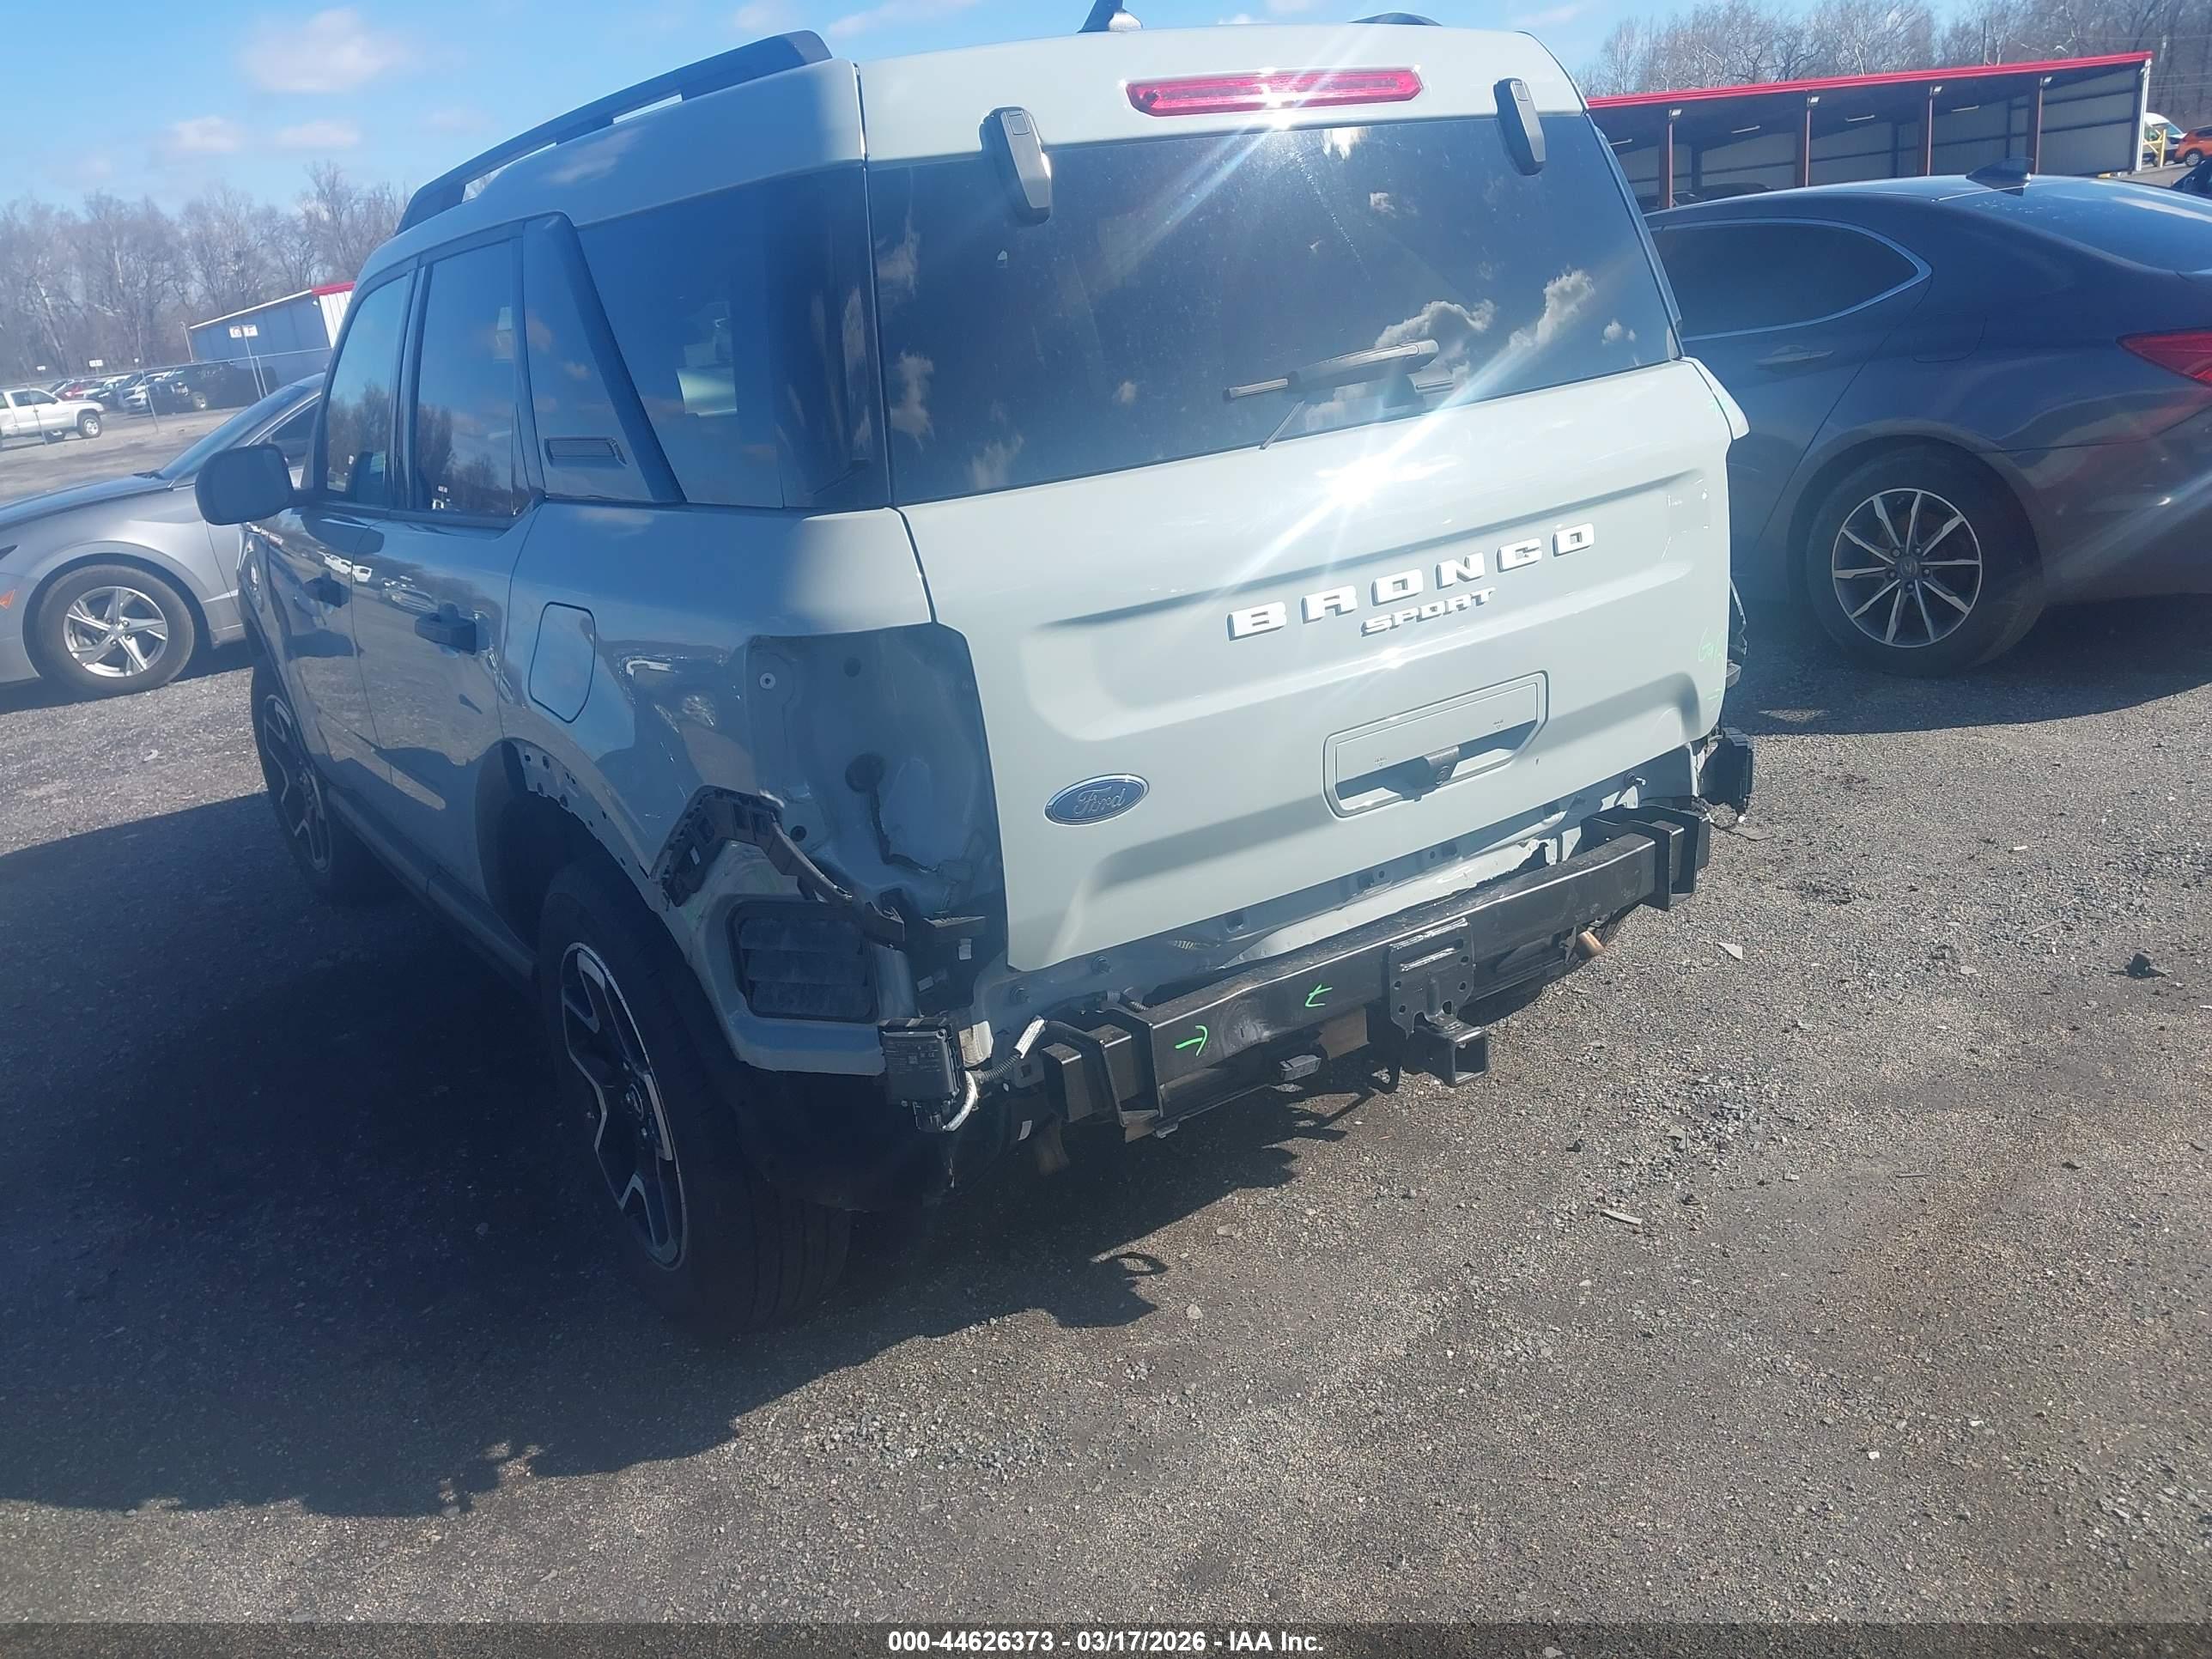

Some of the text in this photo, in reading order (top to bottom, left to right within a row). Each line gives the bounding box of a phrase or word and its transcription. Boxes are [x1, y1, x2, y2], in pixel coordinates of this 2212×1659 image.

[1226, 522, 1595, 641] BRONCO
[1360, 586, 1496, 637] SPORT
[1073, 786, 1127, 817] Ford
